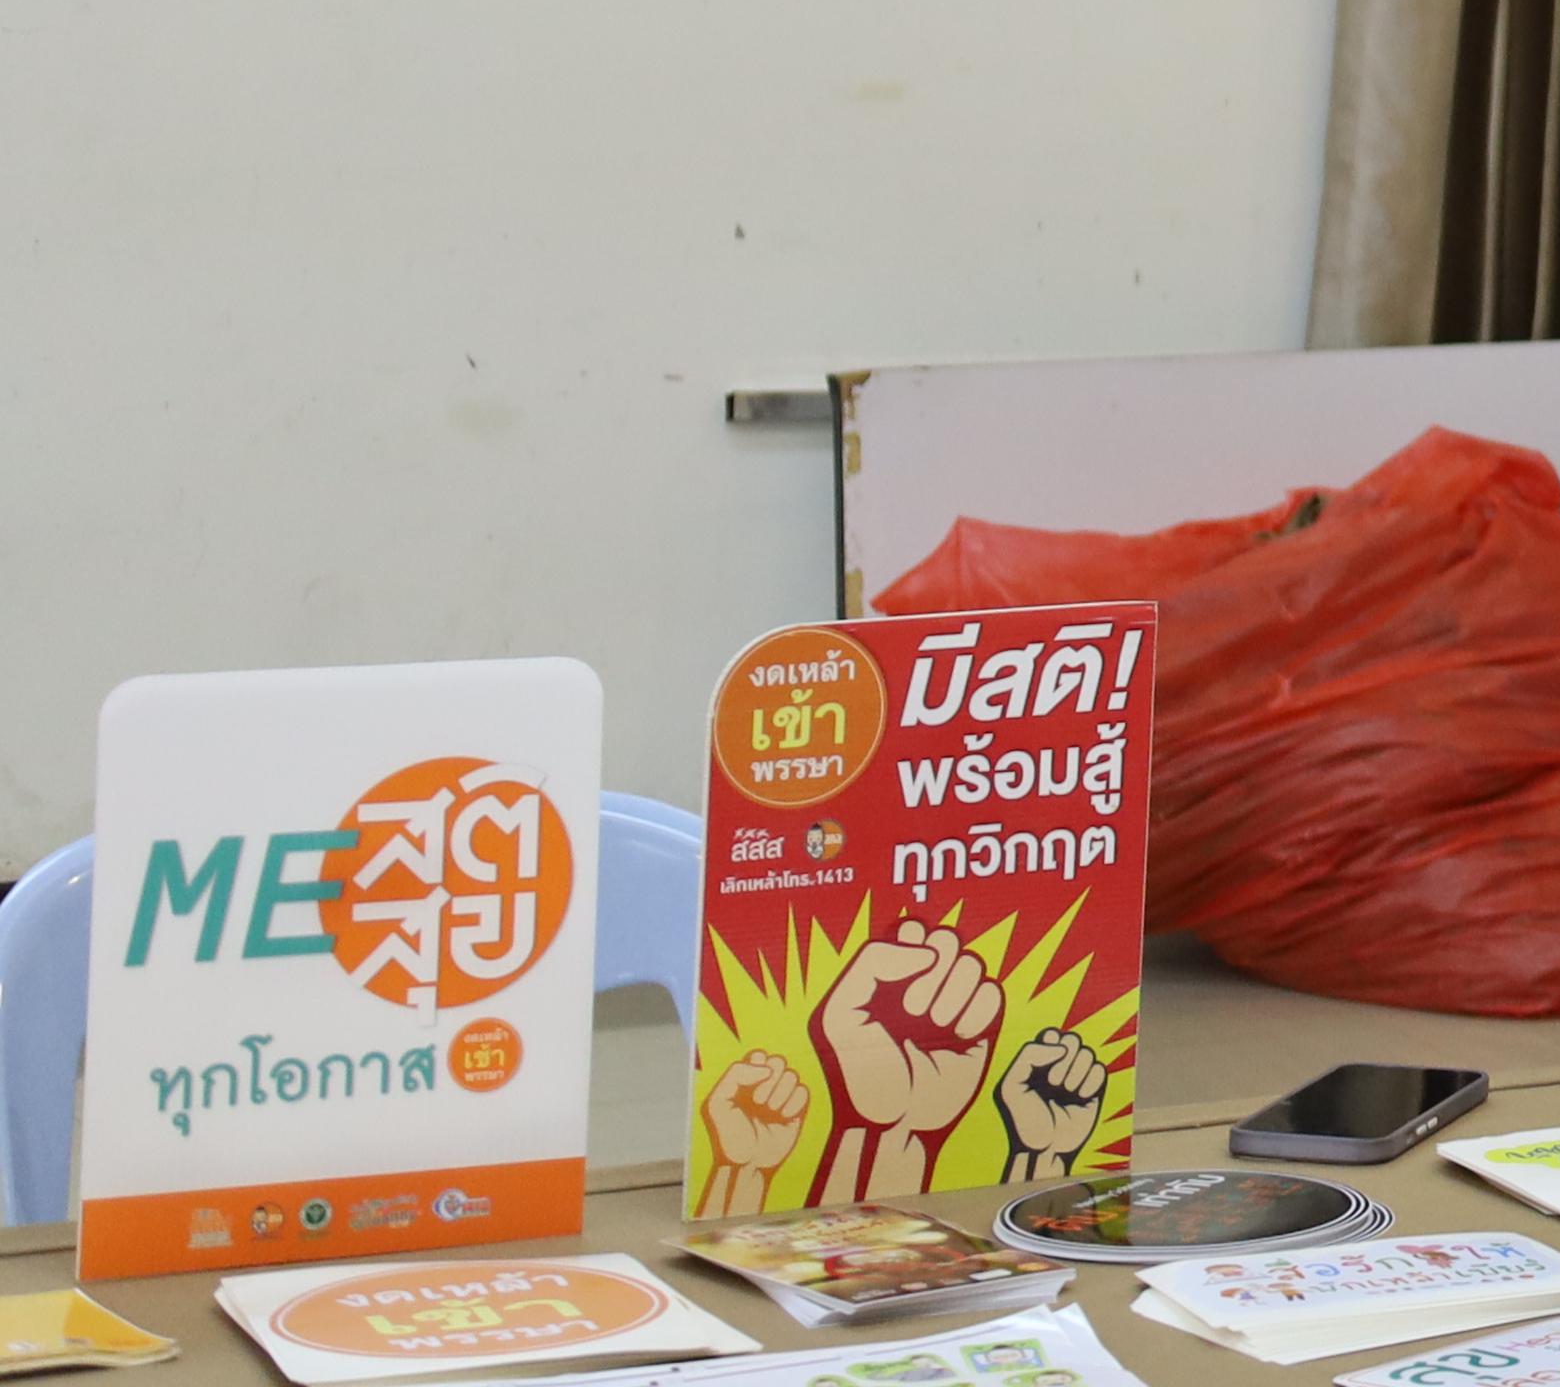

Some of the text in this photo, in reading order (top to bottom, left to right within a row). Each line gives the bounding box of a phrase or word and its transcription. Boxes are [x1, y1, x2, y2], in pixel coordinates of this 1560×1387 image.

[749, 649, 855, 688] งดเหล้า
[901, 622, 1142, 728] มีสติ!
[750, 690, 846, 751] เข้า
[750, 752, 843, 785] พรรษา
[897, 723, 1127, 815] พร้อมสู้
[816, 867, 854, 885] 1413
[892, 819, 1117, 902] ทุกวิกฤต
[124, 829, 361, 968] ME
[150, 1034, 437, 1137] ทุกโอกาส
[336, 1271, 569, 1308] งดเหล้า
[365, 1297, 583, 1335] เข้า
[388, 1319, 599, 1350] พรรษา
